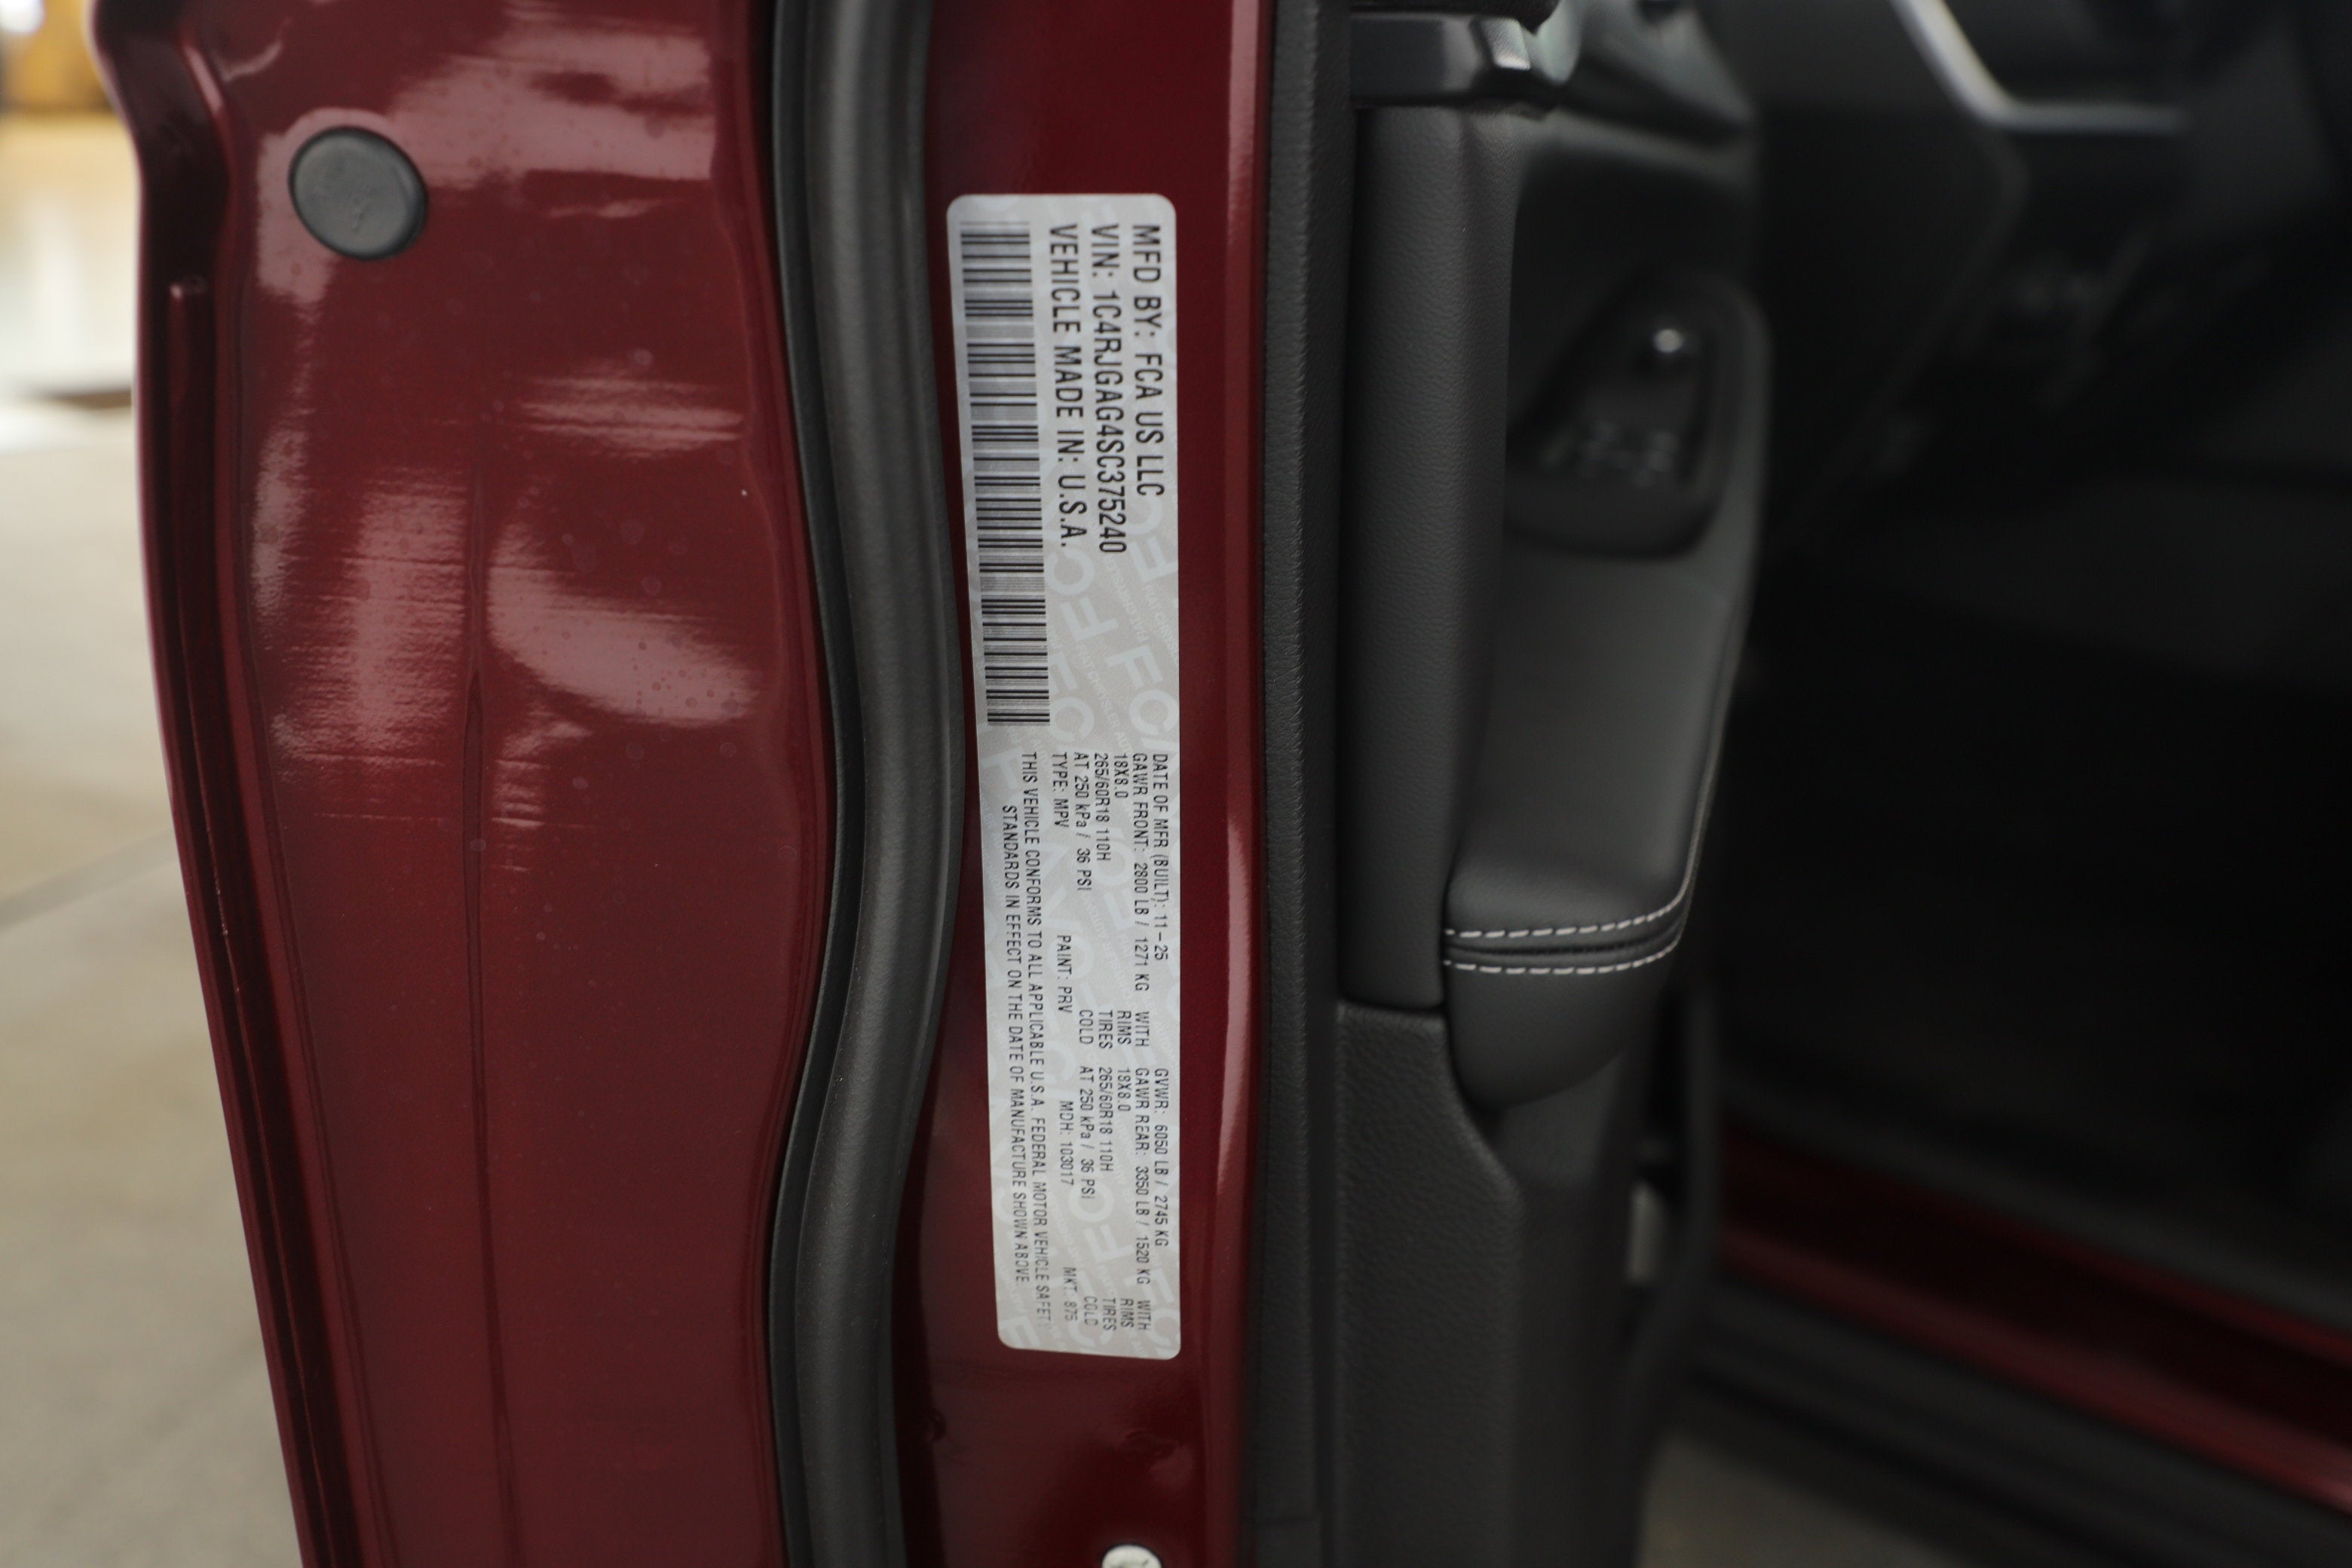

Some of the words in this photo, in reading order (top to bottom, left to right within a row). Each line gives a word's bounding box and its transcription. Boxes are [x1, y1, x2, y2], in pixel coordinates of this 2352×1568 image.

[1091, 224, 1119, 277] VIN:
[1133, 225, 1161, 283] MFD
[1049, 224, 1081, 332] VEHICLE
[1134, 296, 1162, 336] BY:
[1054, 347, 1083, 418] MADE
[1135, 354, 1163, 400] FCA
[1092, 291, 1127, 553] 1C4RJGAG4SC375240
[1135, 412, 1164, 443] US
[1058, 430, 1085, 461] IN:
[1137, 455, 1165, 495] LLC
[1058, 475, 1087, 547] U.S.A.
[1022, 752, 1037, 783] THIS
[1052, 752, 1068, 792] TYPE:
[1074, 752, 1089, 769] AT
[1114, 753, 1129, 798] 18X8.0
[1133, 753, 1148, 795] GAWR
[1153, 754, 1168, 789] DATE
[1075, 776, 1089, 798] 250
[1095, 753, 1110, 822] 265/60R18
[1153, 795, 1168, 812] OF
[1024, 788, 1040, 844] VEHICLE
[1054, 799, 1069, 827] MPV
[1076, 804, 1090, 827] kPa
[1134, 802, 1148, 851] FRONT:
[1003, 806, 1019, 889] STANDARDS
[1096, 828, 1111, 861] 110H
[1154, 819, 1168, 847] MFR
[1076, 848, 1090, 862] 36
[1025, 850, 1042, 925] CONFORMS
[1077, 870, 1092, 890] PSI
[1135, 862, 1148, 893] 2800
[1152, 854, 1168, 908] (BUILT):
[1006, 896, 1020, 908] IN
[1135, 900, 1149, 914] LB
[1006, 914, 1021, 963] EFFECT
[1027, 931, 1042, 948] TO
[1135, 937, 1149, 966] 1271
[1028, 954, 1043, 978] ALL
[1058, 936, 1072, 978] PAINT:
[1008, 970, 1021, 988] ON
[1135, 974, 1149, 991] KG
[1009, 994, 1022, 1020] THE
[1058, 987, 1072, 1012] PRV
[1029, 983, 1044, 1064] APPLICABLE
[1080, 1009, 1094, 1044] COLD
[1098, 1010, 1113, 1049] TIRES
[1117, 1011, 1132, 1044] RIMS
[1135, 1011, 1150, 1046] WITH
[1009, 1027, 1023, 1060] DATE
[1009, 1066, 1024, 1083] OF
[1080, 1066, 1094, 1083] AT
[1117, 1068, 1132, 1111] 18X8.0
[1135, 1068, 1150, 1108] GAWR
[1155, 1068, 1168, 1113] GVWR:
[1030, 1072, 1045, 1112] U.S.A.
[1080, 1089, 1093, 1110] 250
[1099, 1067, 1113, 1134] 265/60R18
[1060, 1101, 1073, 1134] MDH:
[1080, 1116, 1095, 1138] kPa
[1010, 1089, 1026, 1187] MANUFACTURE
[1031, 1118, 1046, 1176] FEDERAL
[1135, 1115, 1150, 1155] REAR:
[1154, 1125, 1168, 1154] 6050
[1060, 1141, 1074, 1186] 103017
[1081, 1159, 1094, 1172] 36
[1100, 1141, 1113, 1171] 110H
[1155, 1161, 1168, 1175] LB
[1081, 1179, 1095, 1198] PSI
[1135, 1166, 1149, 1195] 3350
[1013, 1193, 1027, 1239] SHOWN
[1033, 1182, 1047, 1226] MOTOR
[1136, 1201, 1150, 1215] LB
[1155, 1196, 1168, 1224] 2745
[1136, 1236, 1150, 1263] 1520
[1155, 1230, 1168, 1246] KG
[1034, 1232, 1049, 1280] VEHICLE
[1137, 1269, 1150, 1284] KG
[1083, 1296, 1098, 1326] COLD
[1102, 1297, 1117, 1331] TIRES
[1120, 1298, 1135, 1328] RIMS
[1137, 1300, 1151, 1331] WITH
